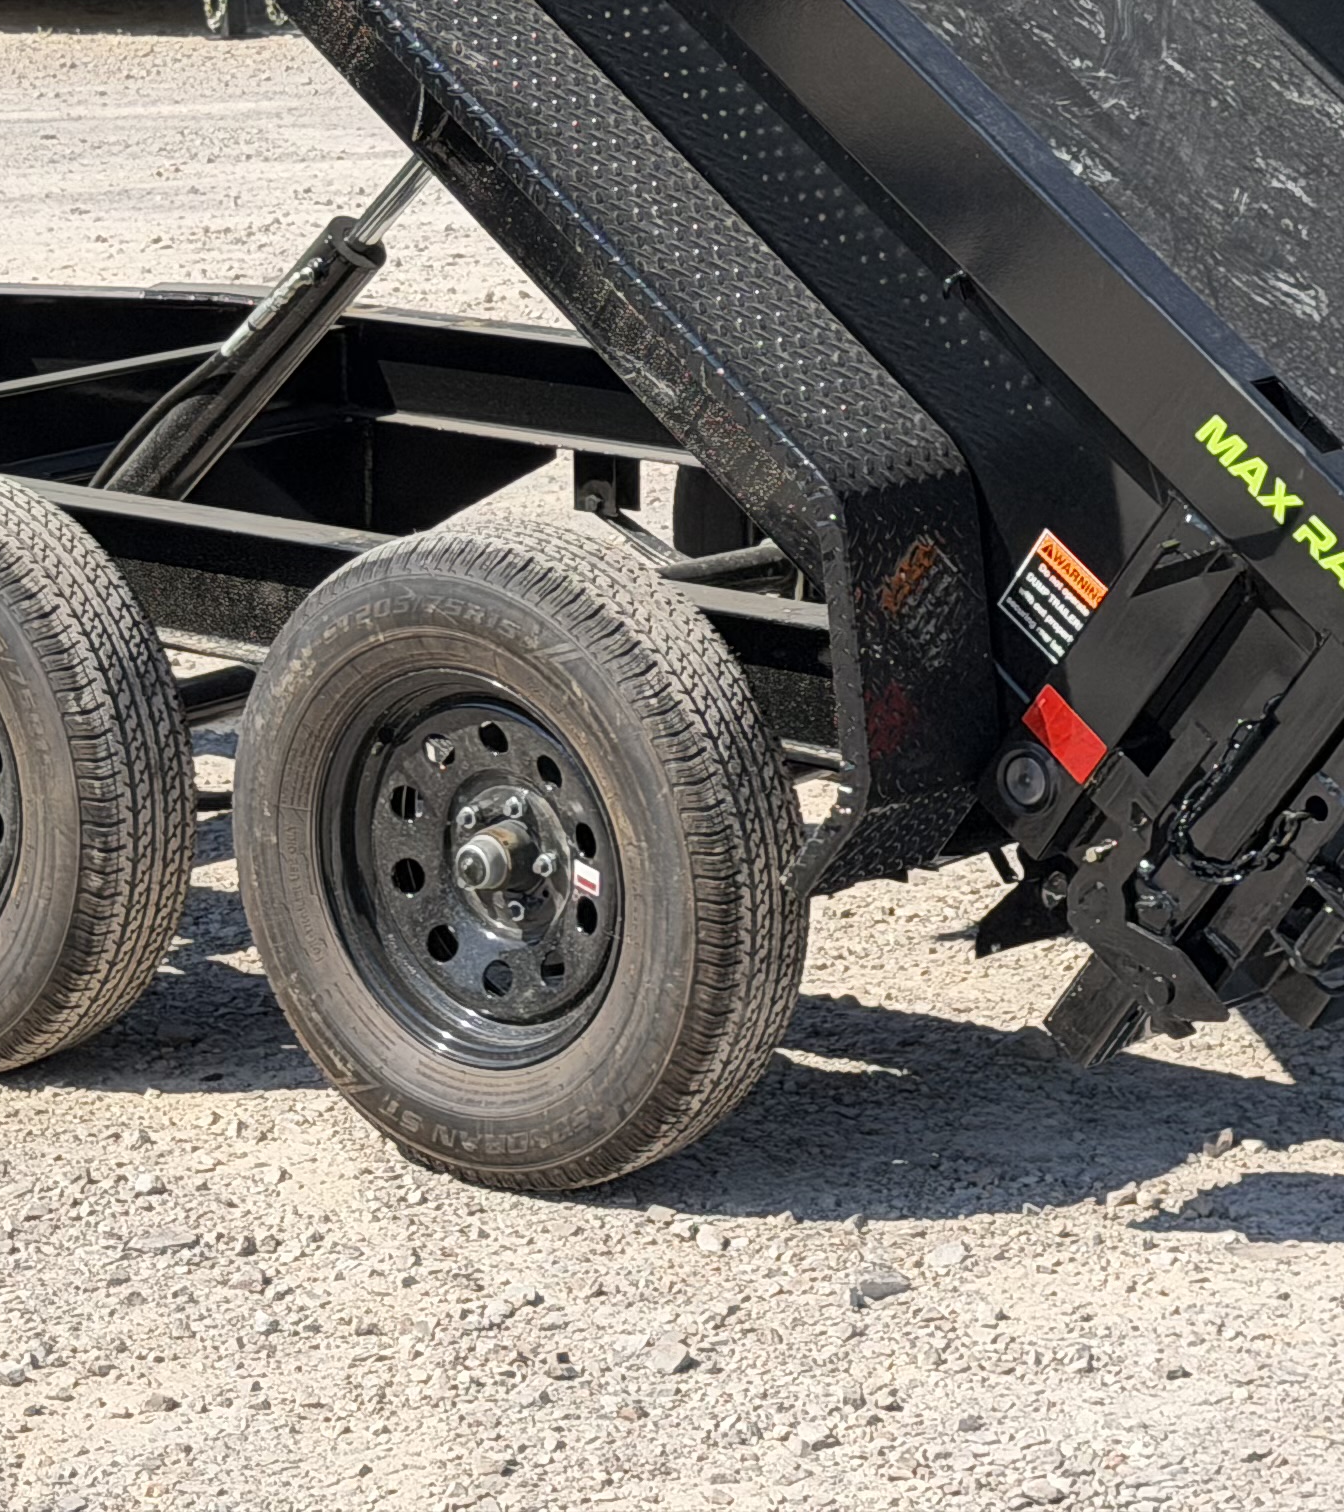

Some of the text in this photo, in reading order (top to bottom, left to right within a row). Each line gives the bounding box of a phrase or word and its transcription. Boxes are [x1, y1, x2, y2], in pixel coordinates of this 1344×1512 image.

[1195, 414, 1305, 525] MAX
[1025, 571, 1051, 596] DUMP
[1006, 596, 1037, 630] securing
